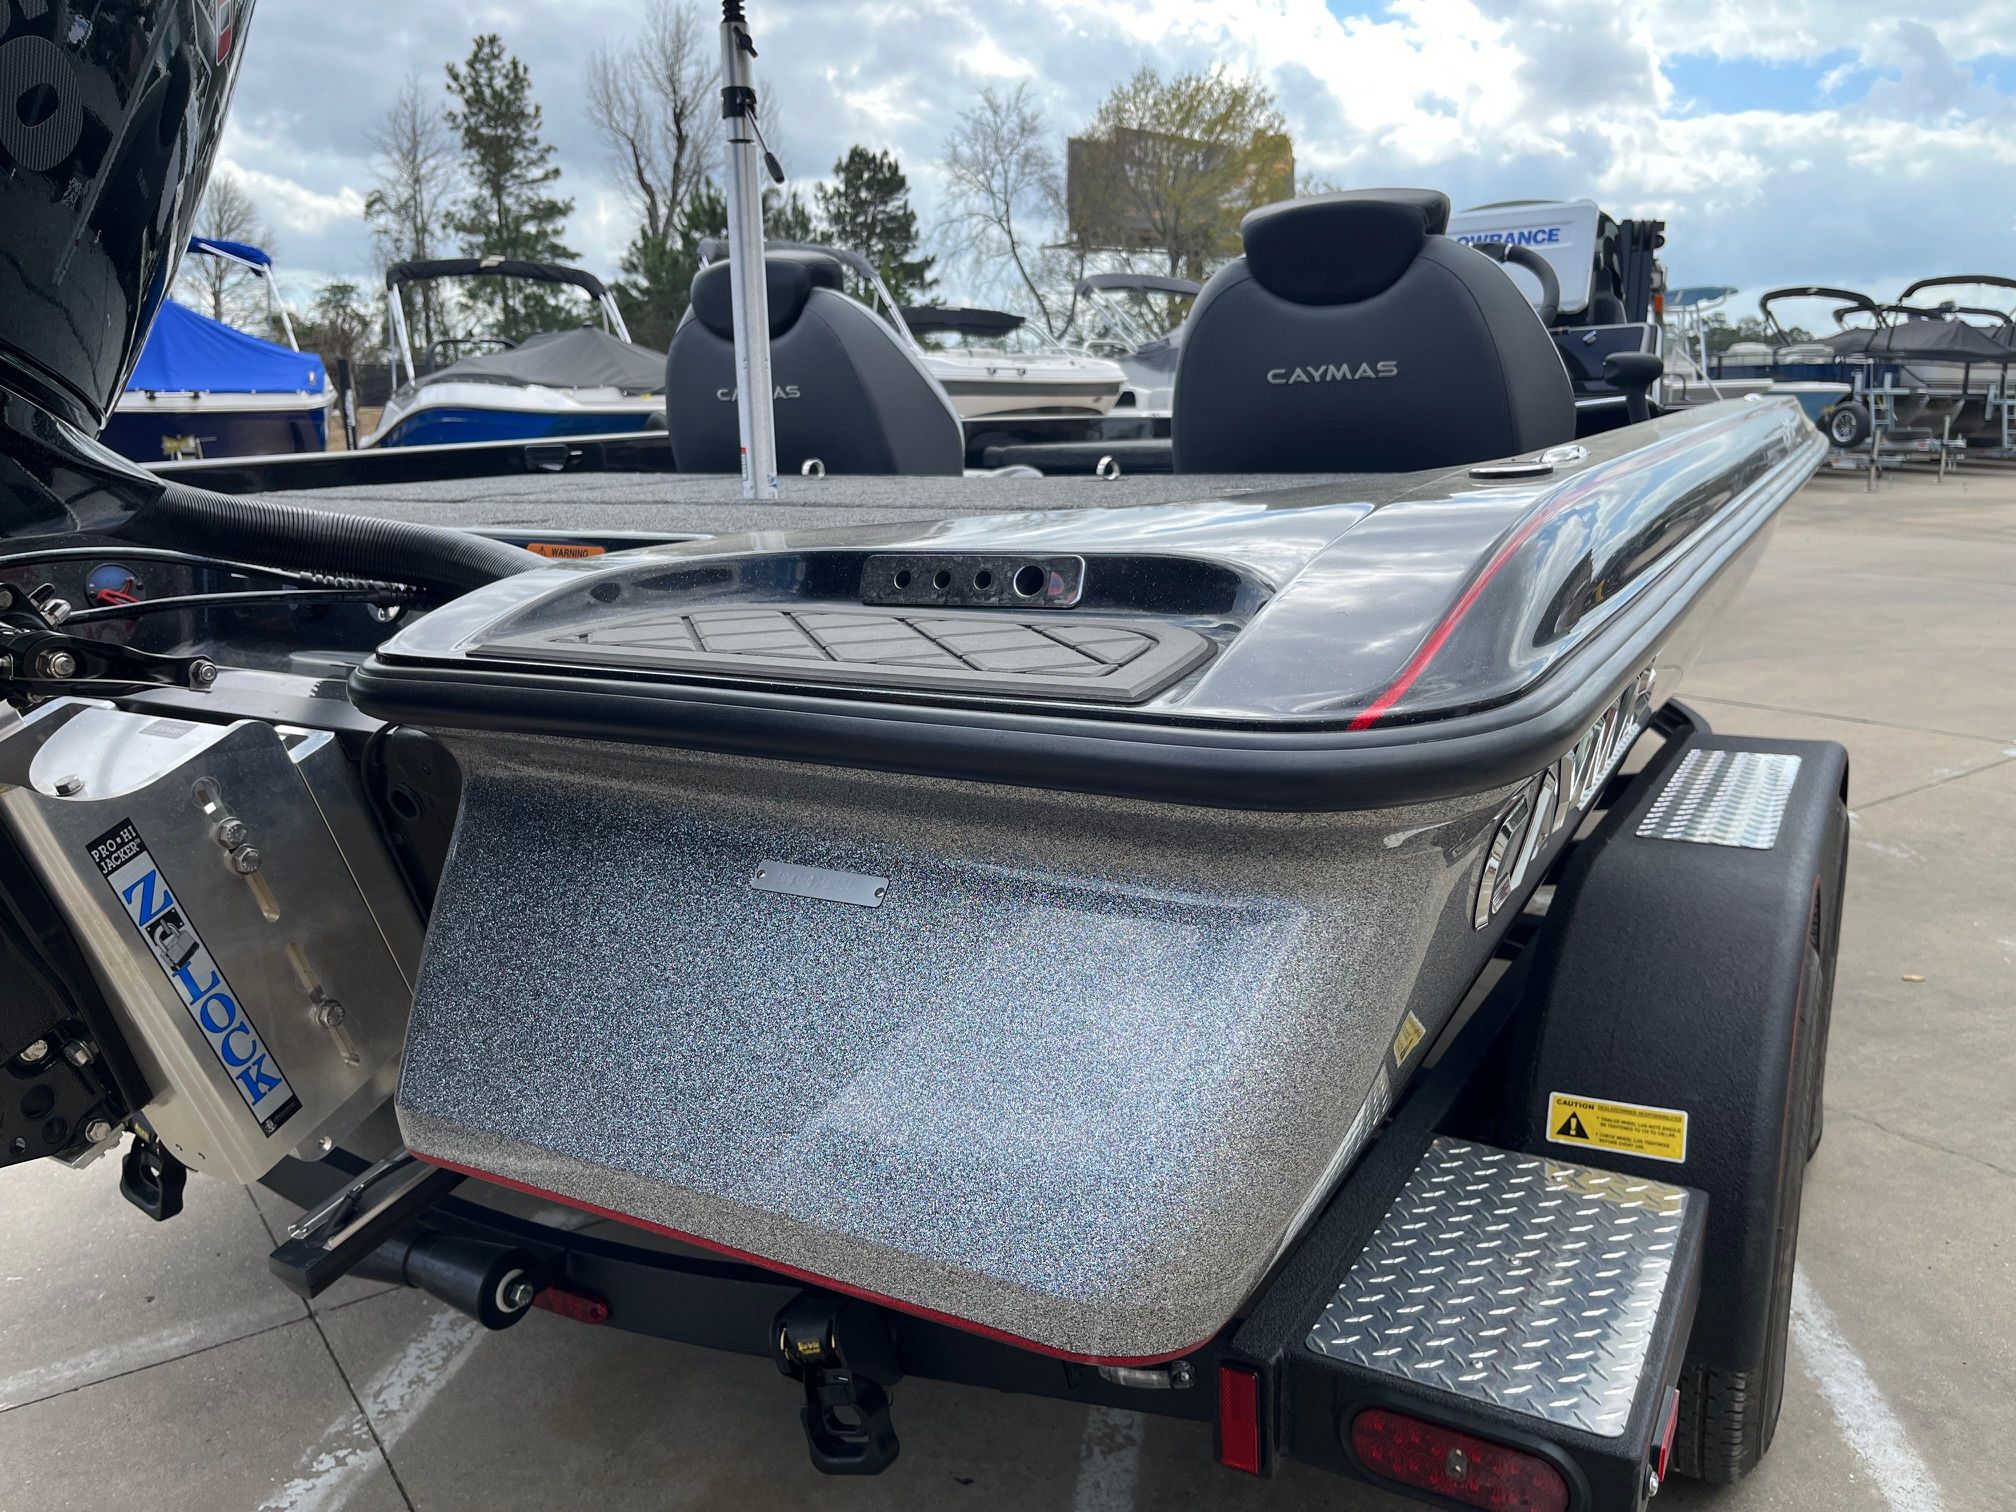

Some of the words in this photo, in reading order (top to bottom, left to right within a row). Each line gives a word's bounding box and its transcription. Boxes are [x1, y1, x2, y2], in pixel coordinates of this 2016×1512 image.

[1457, 228, 1561, 246] OWRANCE
[1266, 360, 1398, 385] CAYMAS
[716, 385, 801, 402] CAS
[551, 547, 589, 558] WARNING
[172, 961, 283, 1106] LOCK
[1556, 1098, 1595, 1111] CAUTION
